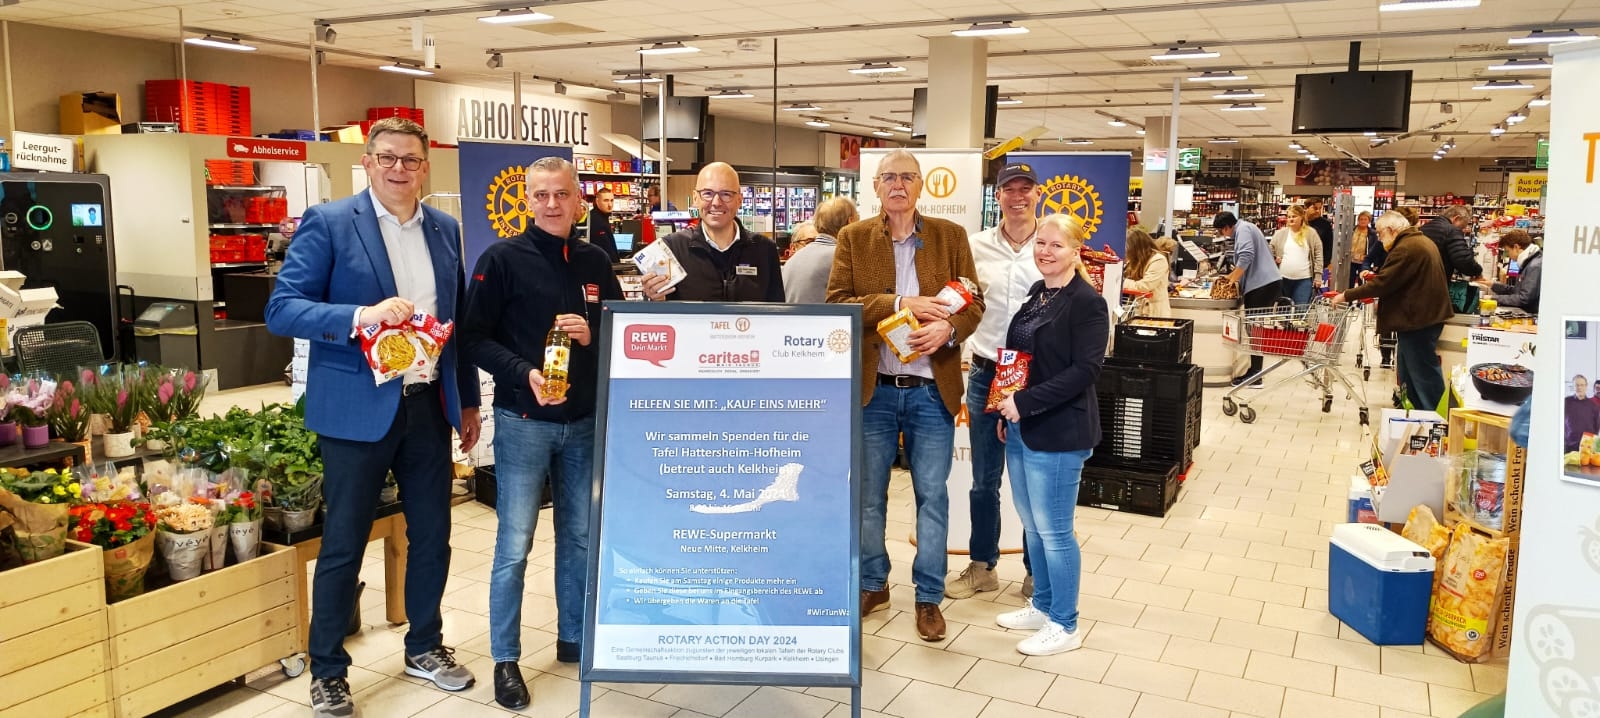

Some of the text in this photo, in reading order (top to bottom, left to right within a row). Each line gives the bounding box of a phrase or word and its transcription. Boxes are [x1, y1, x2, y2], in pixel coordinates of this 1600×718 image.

[22, 140, 61, 154] Leergut-
[252, 145, 300, 156] Abholservice
[16, 152, 68, 165] rücknahme
[1050, 182, 1083, 193] ROTARY
[1518, 178, 1532, 186] Aus
[710, 321, 731, 330] TAFEL
[631, 332, 668, 343] REWE
[784, 335, 825, 348] Rotary
[698, 351, 749, 364] caritas
[772, 350, 825, 358] Club Kelkheim
[629, 399, 671, 409] HELFEN
[673, 399, 691, 409] SIE
[693, 399, 718, 409] MIT:
[759, 399, 784, 409] EINS
[645, 431, 809, 443] Wir sammeln Spenden für die
[652, 447, 802, 457] Tafel Hattersheim-Hofheim
[659, 463, 706, 475] (betreut
[708, 463, 735, 474] auch
[1510, 466, 1521, 507] schenkt
[665, 488, 717, 500] Samstag,
[719, 489, 730, 499] 4.
[733, 489, 755, 499] Mai
[1508, 507, 1518, 534] Wein
[673, 529, 777, 541] REWE-Supermarkt
[680, 545, 769, 554] Neue Mitte, Kelkheim
[655, 567, 680, 575] können
[683, 578, 712, 586] Samstag
[723, 588, 779, 596] Eingangsbereich
[1502, 586, 1513, 625] schenkt
[658, 635, 798, 645] ROTARY ACTION DAY 2024
[1498, 625, 1509, 650] Wein
[808, 648, 827, 656] Rotary
